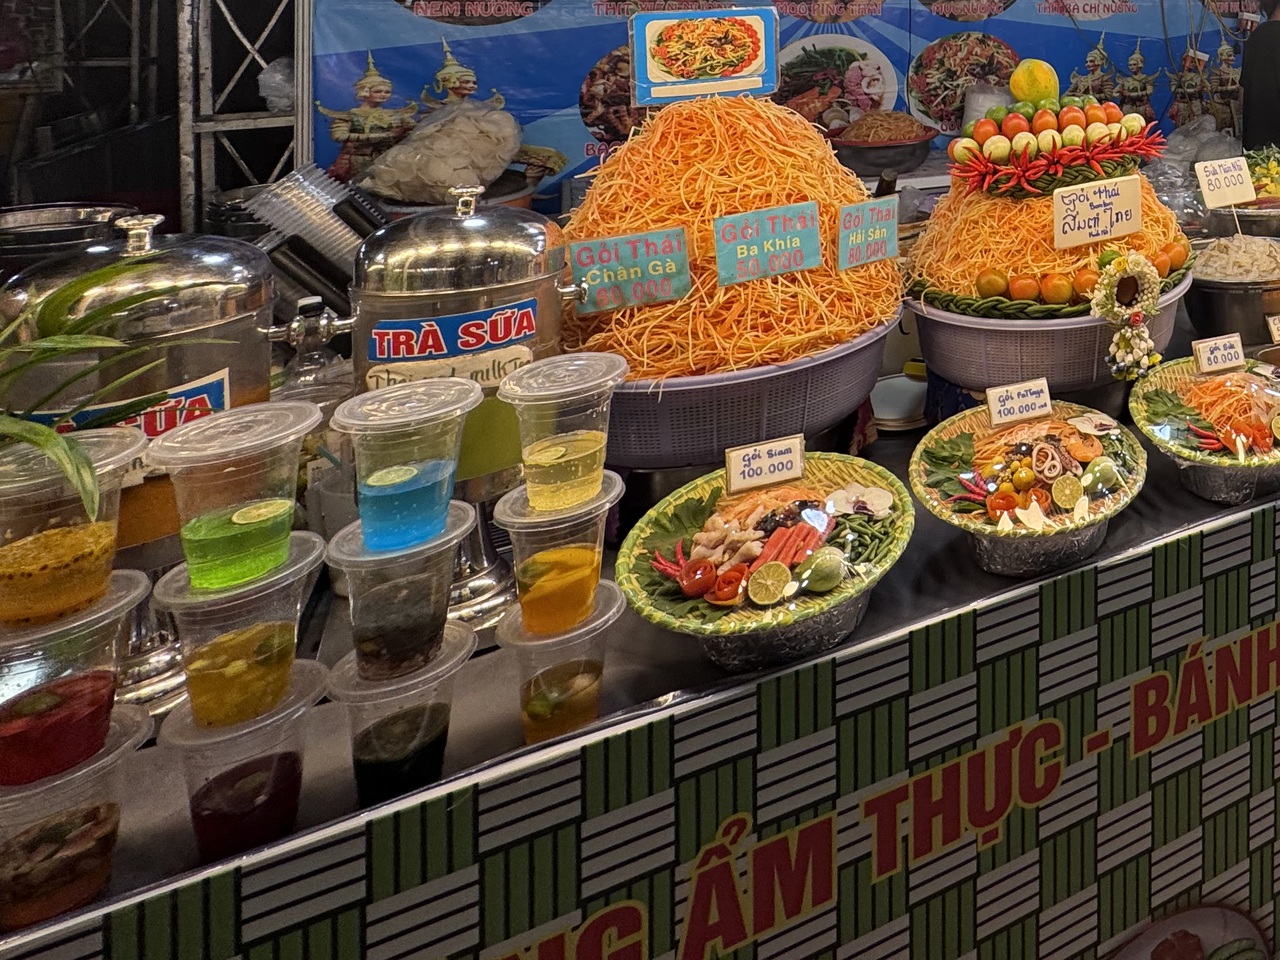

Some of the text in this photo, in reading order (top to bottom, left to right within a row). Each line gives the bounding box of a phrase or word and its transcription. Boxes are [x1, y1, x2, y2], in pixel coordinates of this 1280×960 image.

[413, 0, 534, 17] NEM NƯỚNG
[592, 2, 632, 19] THỊT
[811, 2, 846, 17] PING
[721, 210, 816, 245] Gỏi Thái
[842, 203, 896, 232] Gỏi Thái
[736, 236, 801, 259] Ba Khía
[849, 227, 888, 246] Hải Sản
[576, 232, 683, 269] Gỏi Thái
[848, 240, 888, 265] 80.000
[585, 258, 677, 287] Chân Gà
[735, 248, 804, 281] 50.000
[595, 277, 672, 308] 80.000
[372, 307, 537, 358] TRÀ SỮA
[997, 402, 1037, 418] 100.000
[766, 447, 792, 459] Siam
[739, 460, 794, 480] 100.000
[678, 811, 838, 960] ẨM
[858, 716, 1066, 885] THỰC
